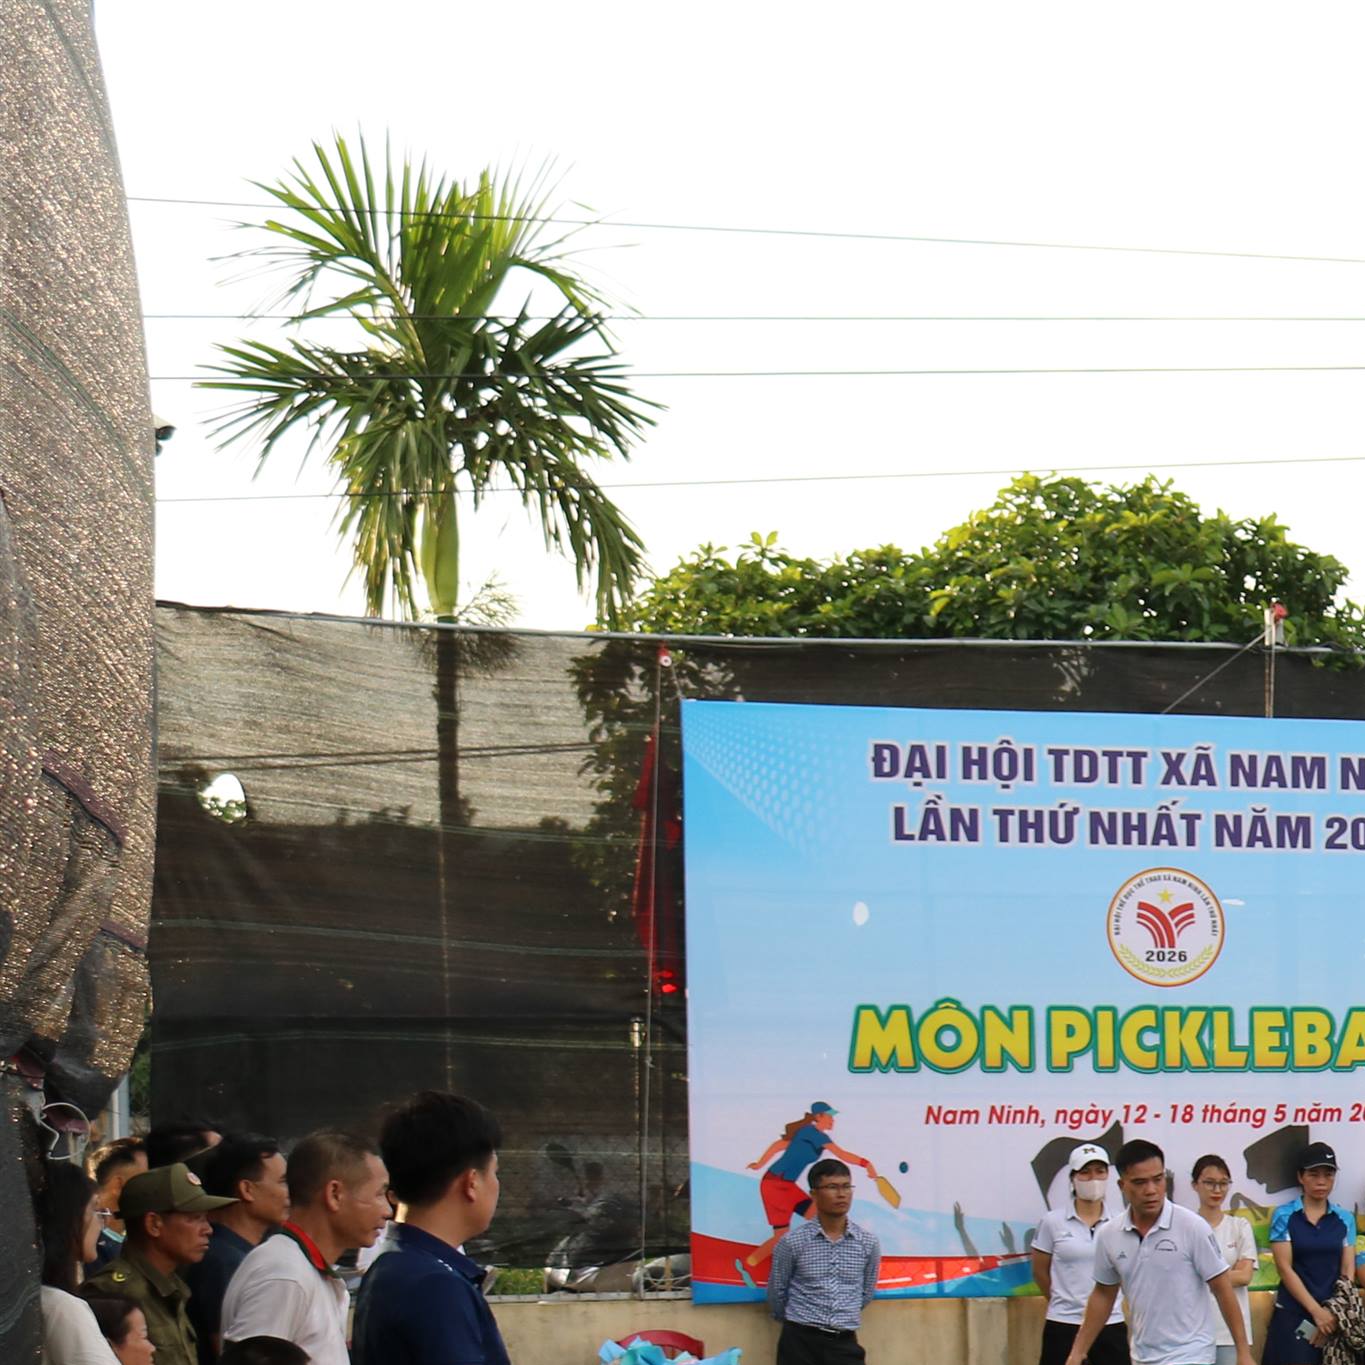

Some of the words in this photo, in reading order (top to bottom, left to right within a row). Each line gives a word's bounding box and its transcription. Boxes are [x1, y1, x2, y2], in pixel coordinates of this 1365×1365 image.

[872, 743, 947, 787] ĐẠI
[961, 739, 1034, 789] HỘI
[1047, 748, 1148, 785] TDTT
[1160, 745, 1218, 787] XÃ
[1230, 753, 1327, 789] NAM
[894, 794, 980, 842] LẦN
[992, 802, 1080, 844] THỨ
[1089, 800, 1201, 847] NHẤT
[1214, 806, 1312, 849] NĂM
[1145, 950, 1188, 962] 2026
[849, 998, 1034, 1074] MÔN
[924, 1105, 980, 1125] Nam
[987, 1105, 1046, 1128] Ninh,
[1054, 1103, 1114, 1130] ngày
[1122, 1104, 1149, 1124] 12
[1170, 1104, 1194, 1124] 18
[1202, 1102, 1267, 1128] tháng
[1273, 1103, 1287, 1123] 5
[1293, 1102, 1342, 1122] năm
